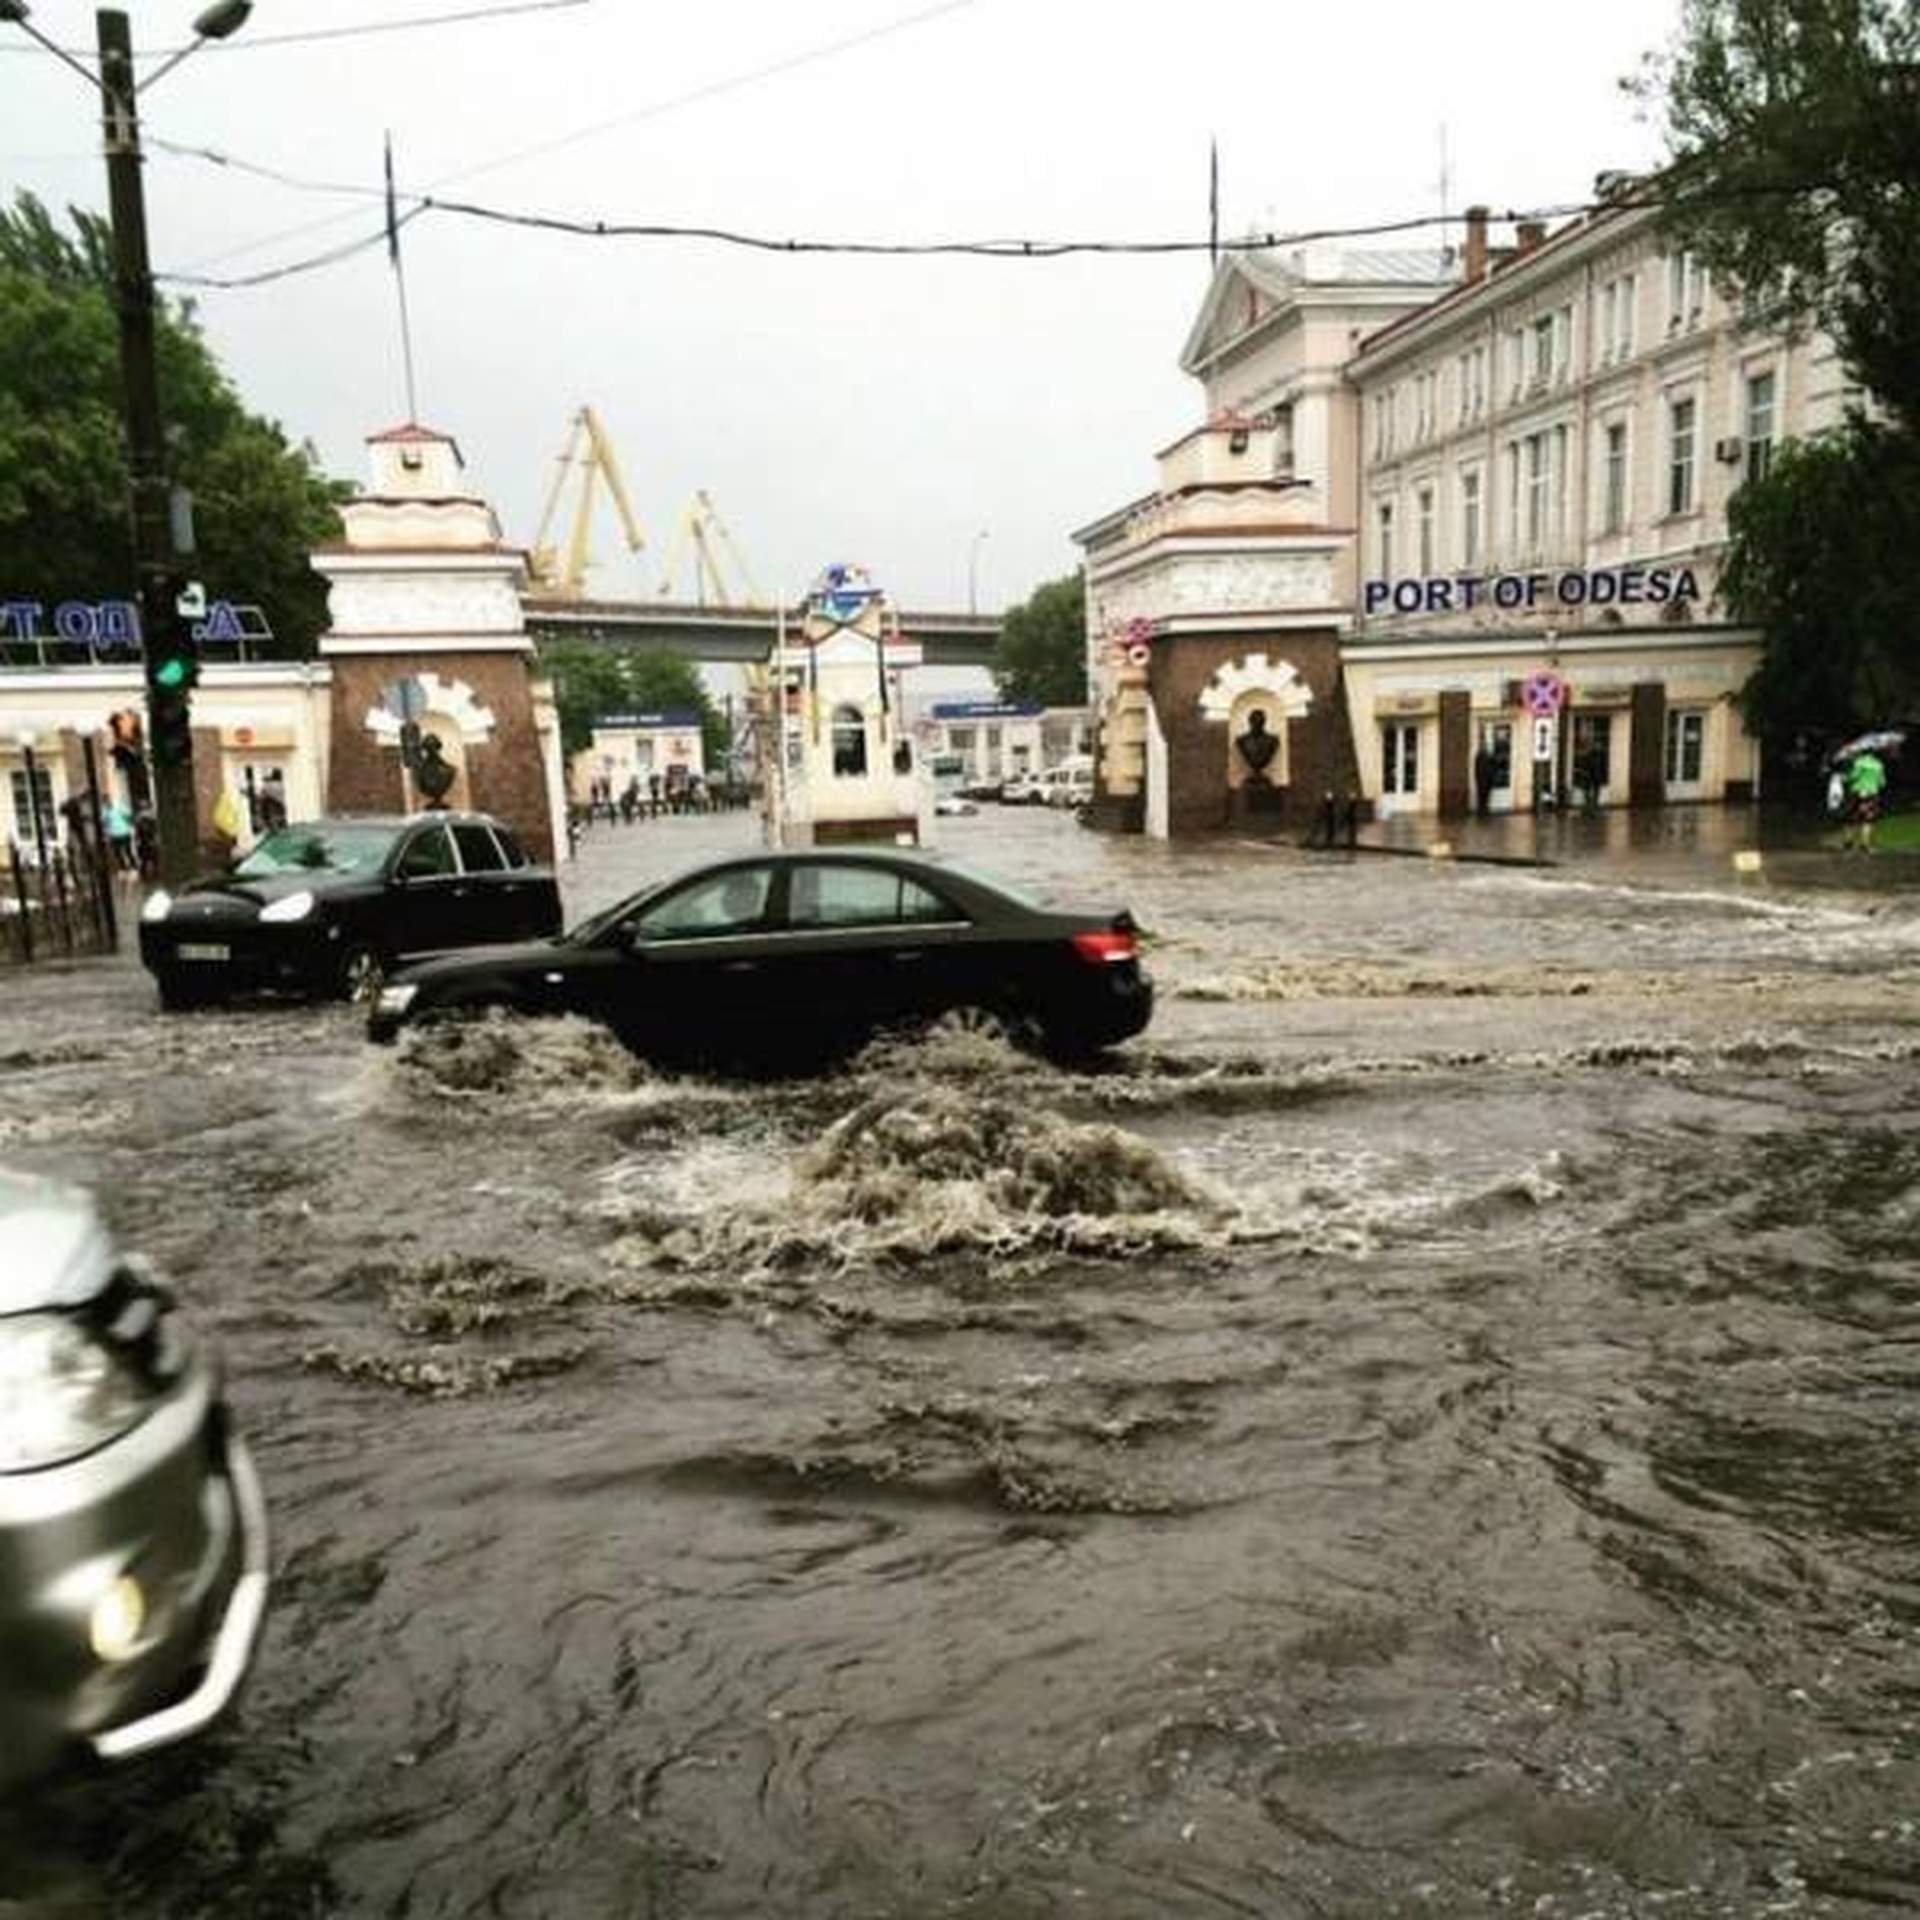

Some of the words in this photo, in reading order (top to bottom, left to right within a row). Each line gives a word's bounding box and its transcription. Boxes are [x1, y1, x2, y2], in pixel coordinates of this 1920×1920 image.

[1364, 578, 1484, 615] PORT
[1493, 574, 1549, 609] OF
[1557, 568, 1700, 605] ODESA
